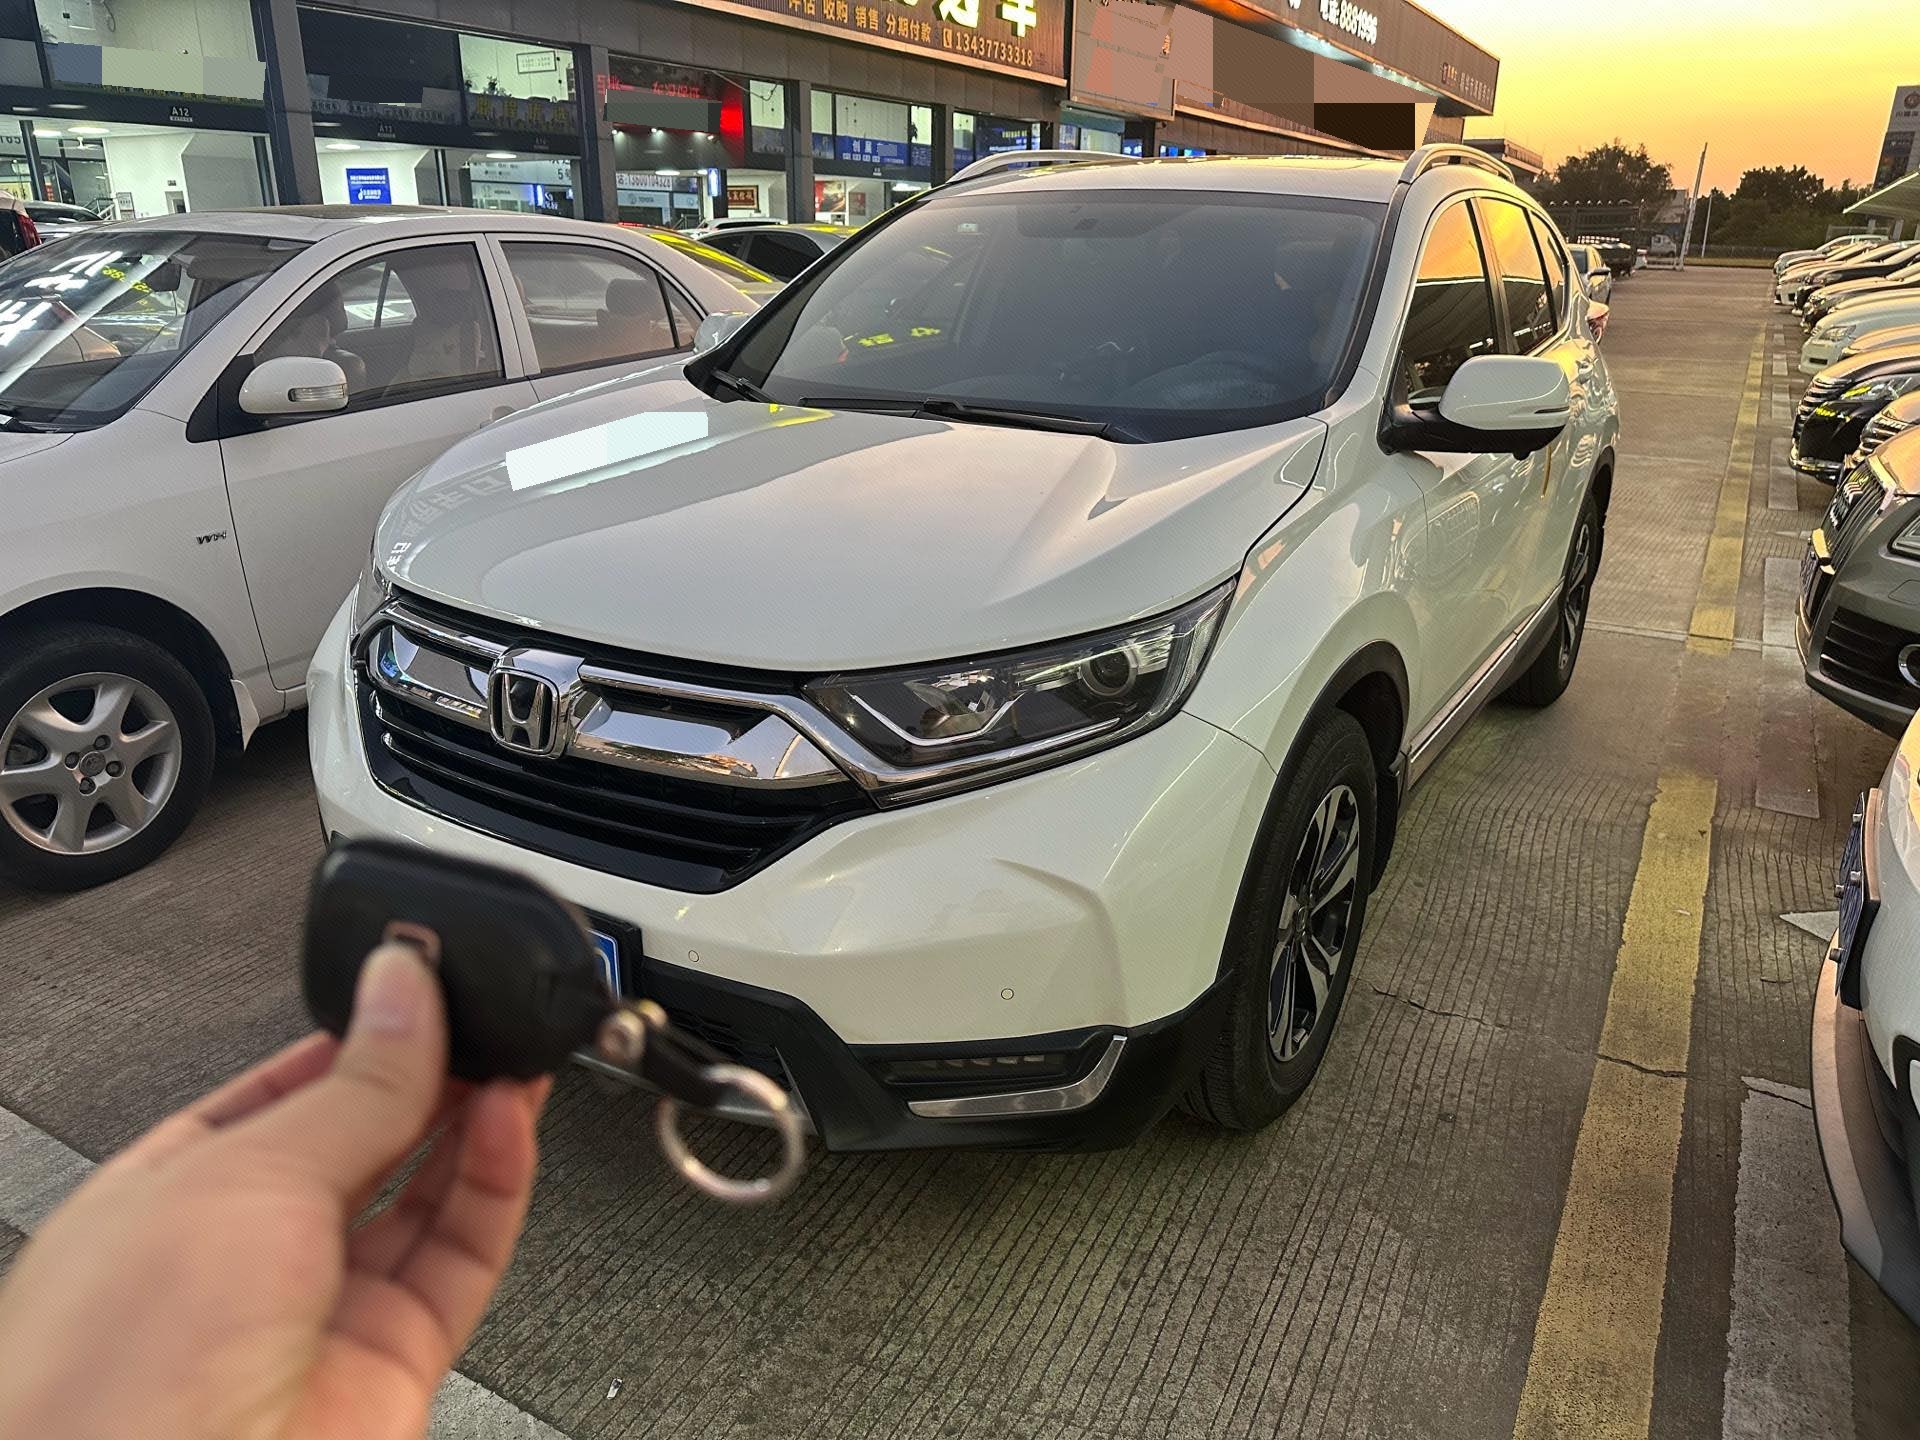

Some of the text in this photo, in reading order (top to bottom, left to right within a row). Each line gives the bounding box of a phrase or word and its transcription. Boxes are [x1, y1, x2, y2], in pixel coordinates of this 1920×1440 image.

[823, 0, 849, 24] 收购
[855, 5, 879, 31] 销售
[886, 12, 931, 43] 分期付款
[955, 31, 1034, 68] 13437733318
[172, 106, 190, 117] A12
